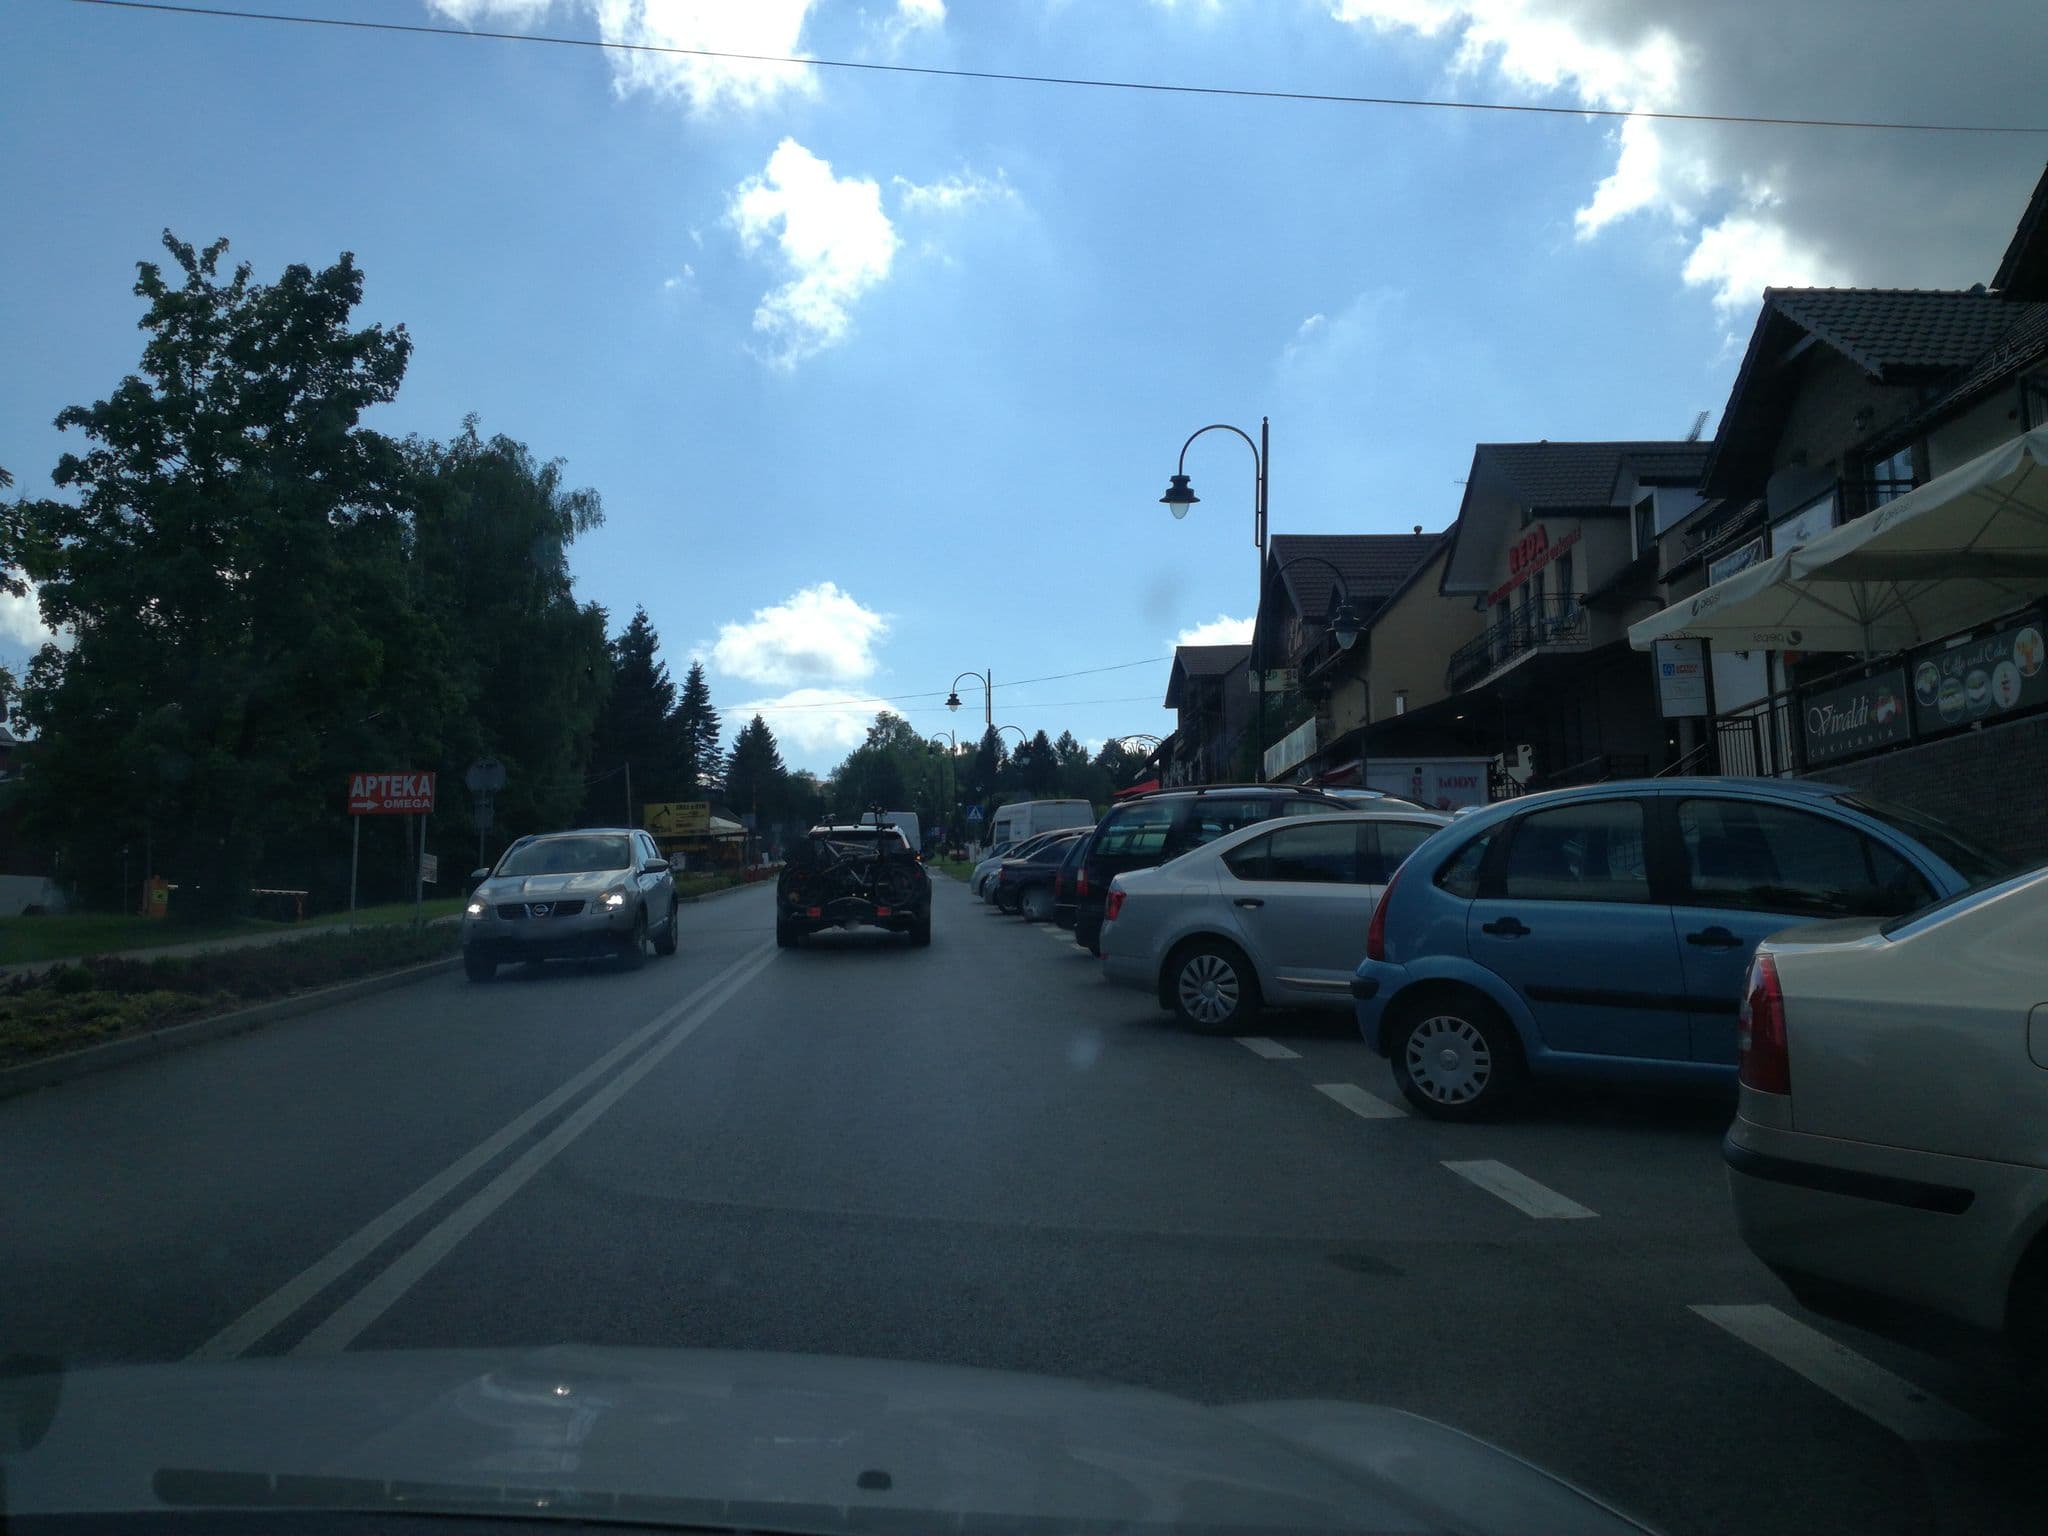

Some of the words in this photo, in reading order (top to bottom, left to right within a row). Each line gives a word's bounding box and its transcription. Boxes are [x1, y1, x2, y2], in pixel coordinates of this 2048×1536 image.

[1808, 696, 1869, 736] Vivaldi
[351, 775, 432, 798] APTEKA
[383, 799, 432, 809] OMEGA
